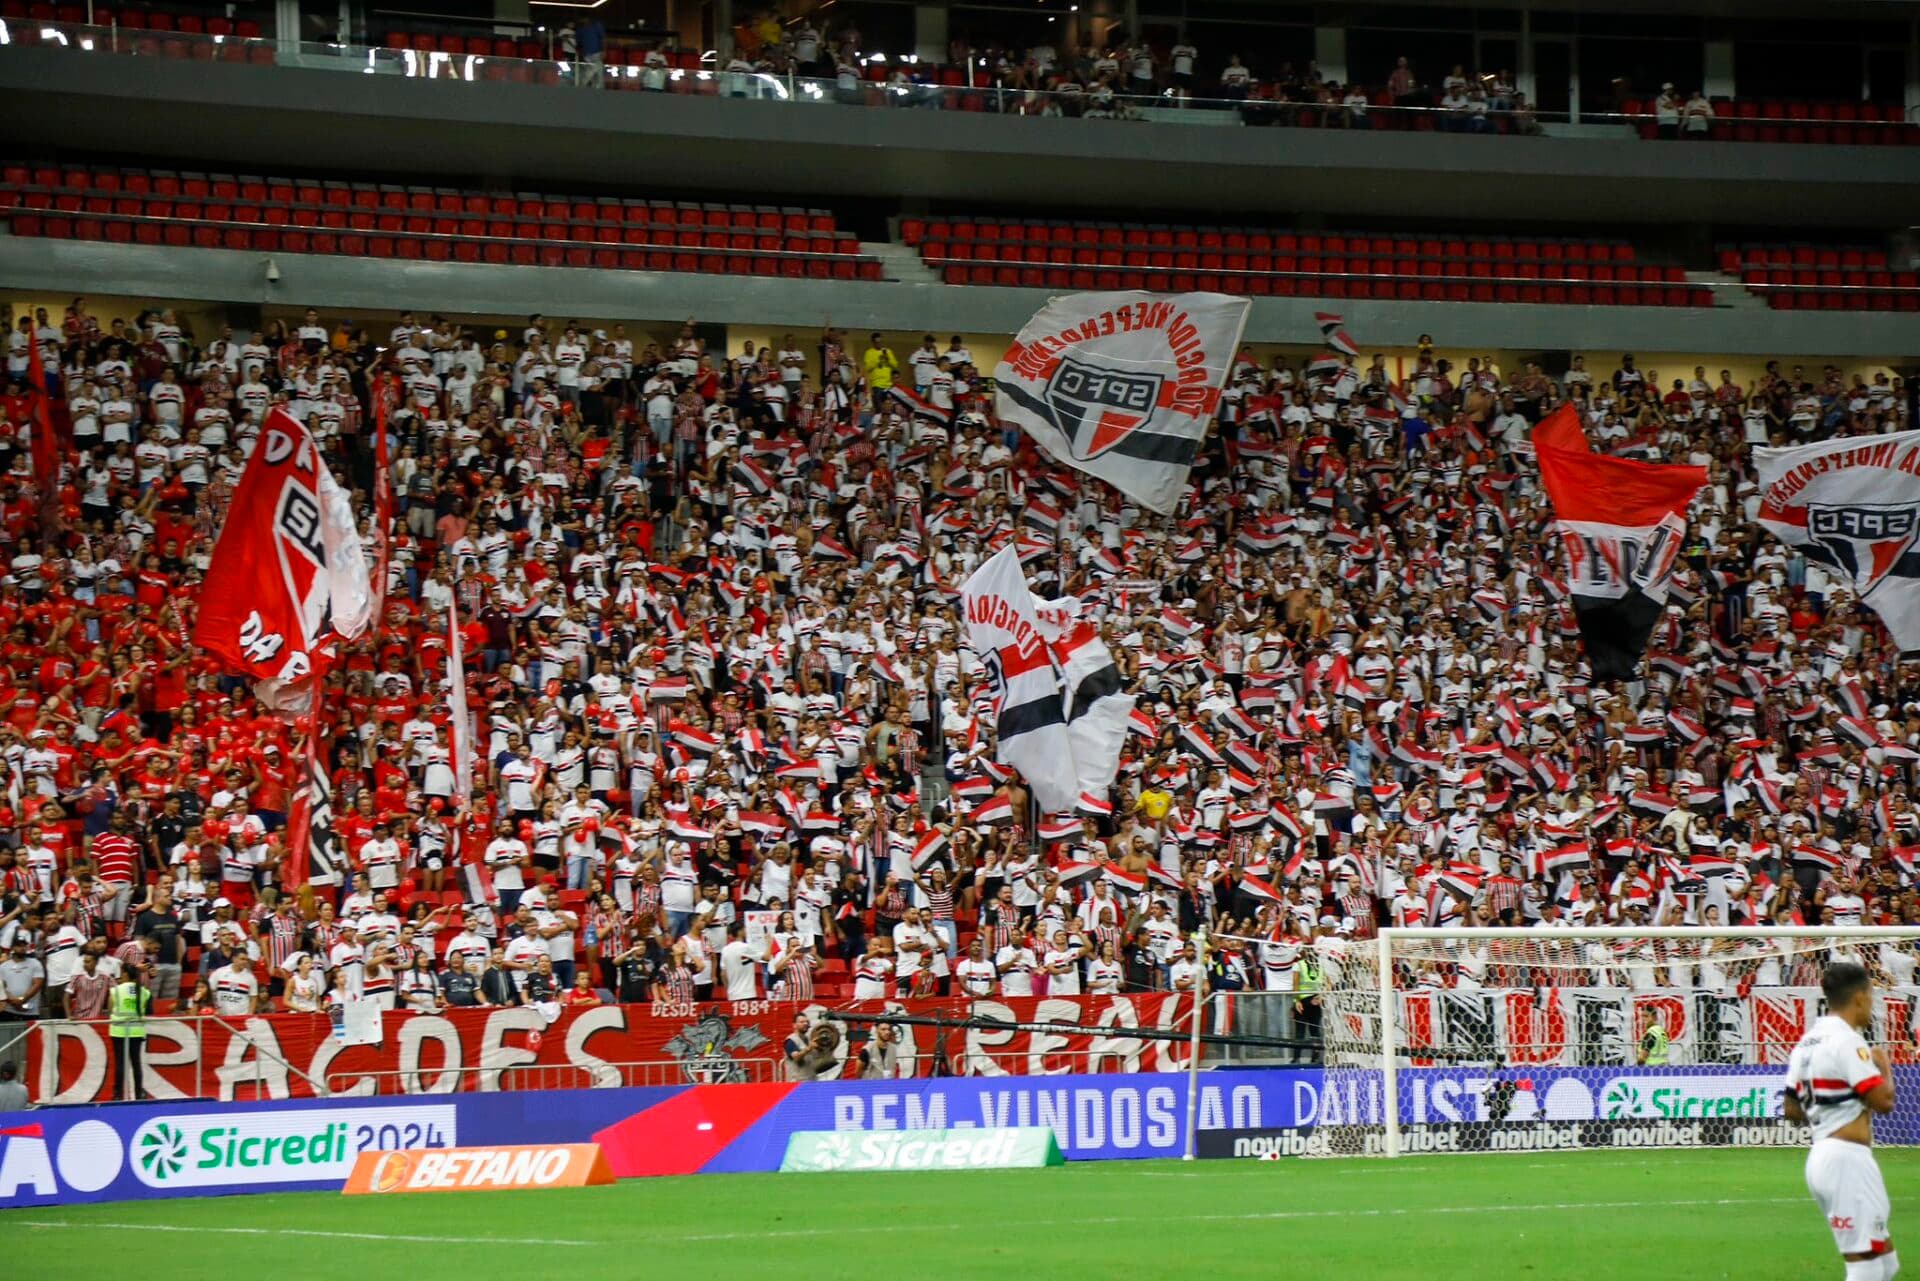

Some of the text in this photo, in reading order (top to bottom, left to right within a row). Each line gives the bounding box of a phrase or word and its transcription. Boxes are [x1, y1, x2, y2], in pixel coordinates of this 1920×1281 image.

[651, 1001, 770, 1018] DESDE 1984
[1652, 1087, 1767, 1119] Sicredi
[197, 1122, 348, 1169] Sicredi
[357, 1122, 445, 1152] 2024
[1234, 1129, 1332, 1157] novibet
[1491, 1122, 1583, 1150] novibet
[1612, 1120, 1703, 1147] novibet
[1733, 1119, 1813, 1145] novibe
[855, 1129, 1019, 1169] Sicredi
[407, 1149, 571, 1188] BETANO
